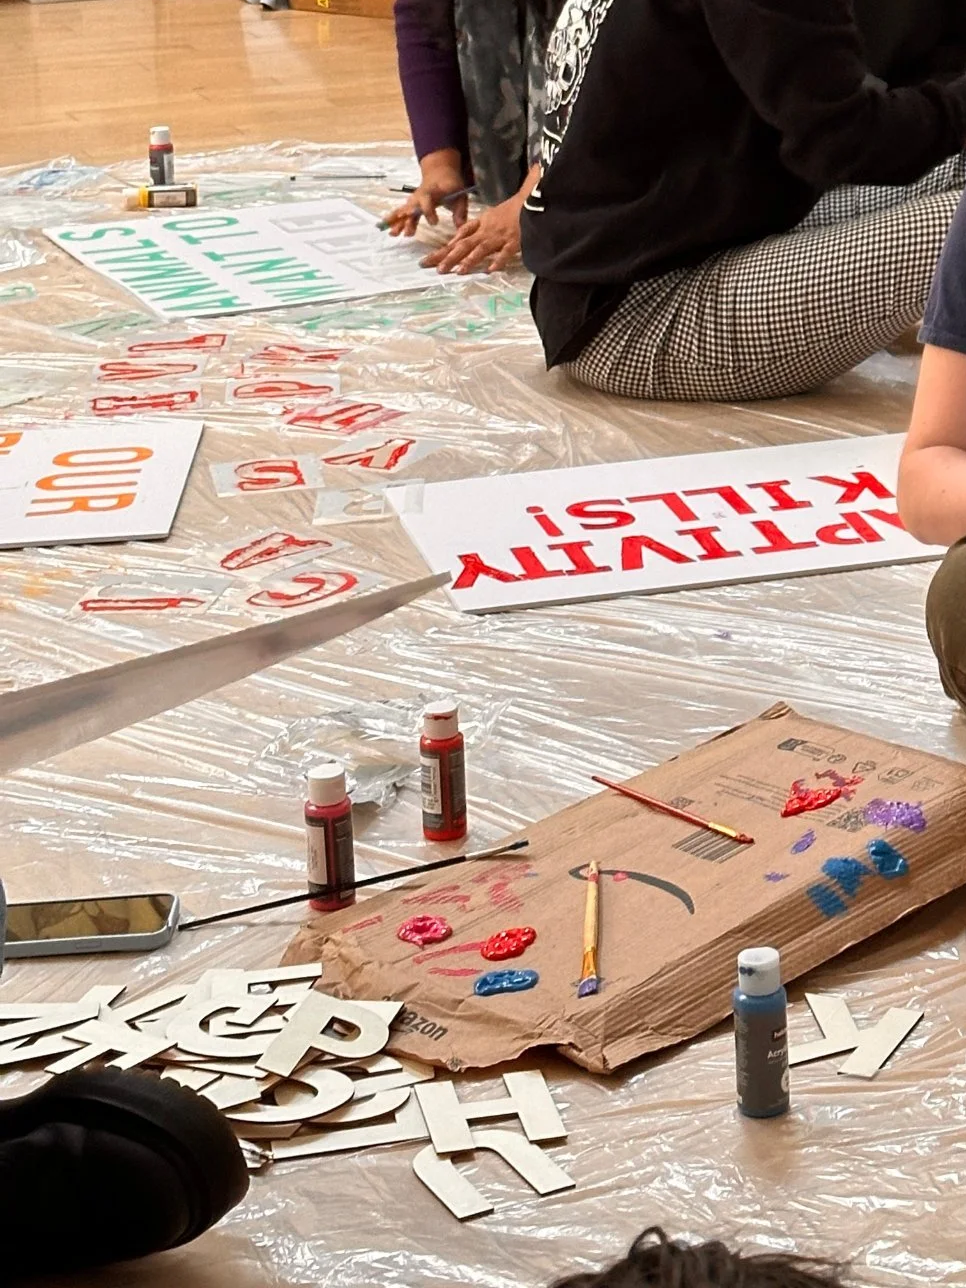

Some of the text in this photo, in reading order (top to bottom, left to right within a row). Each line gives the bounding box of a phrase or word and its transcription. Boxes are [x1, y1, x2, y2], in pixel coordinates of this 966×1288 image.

[162, 215, 259, 245] TO
[58, 226, 250, 312] ANIMALS
[203, 247, 354, 302] WANT
[25, 446, 154, 518] OUR
[526, 471, 896, 537] KILLS!
[382, 996, 448, 1041] azon
